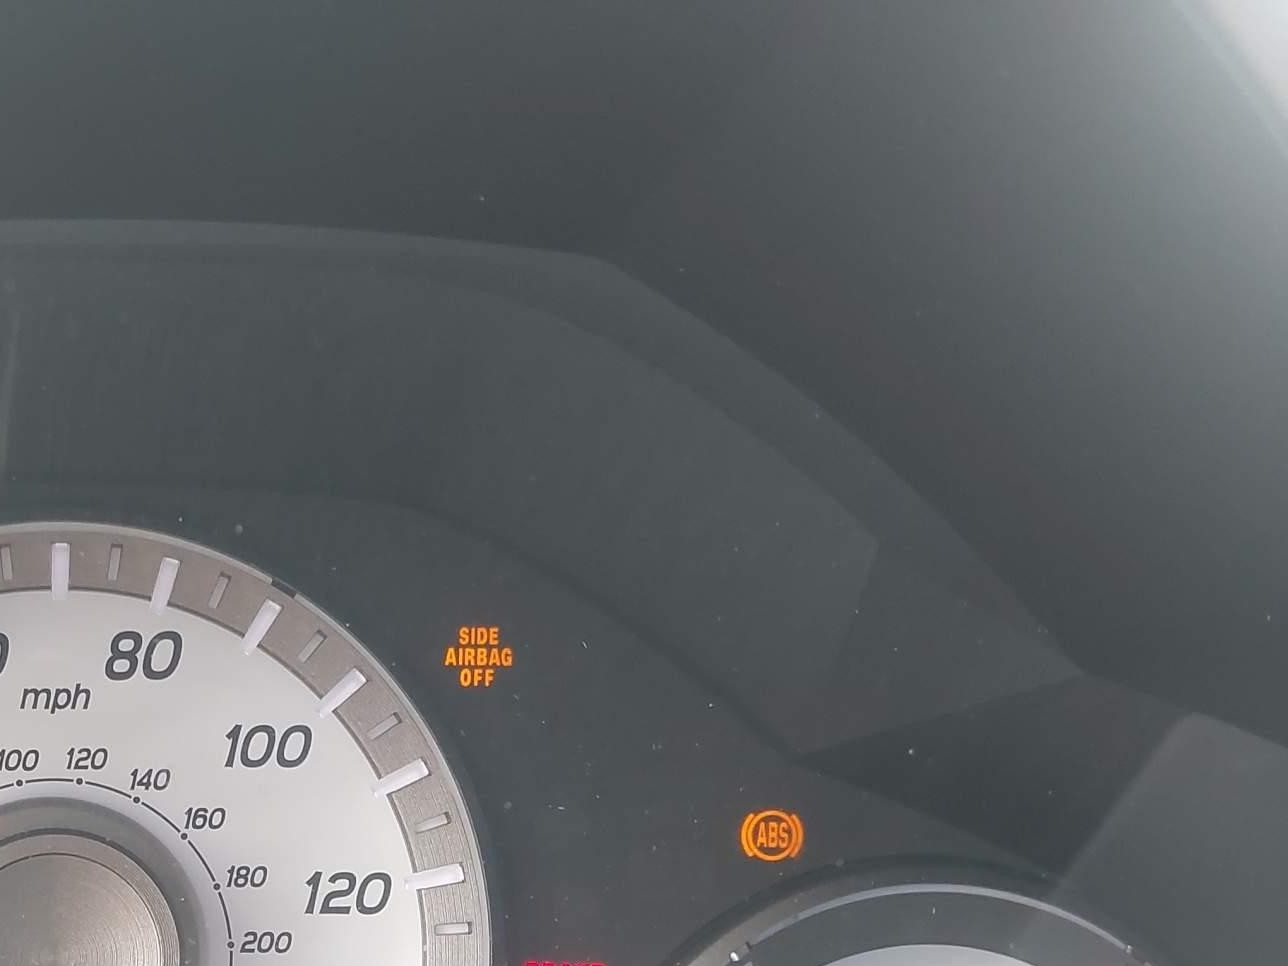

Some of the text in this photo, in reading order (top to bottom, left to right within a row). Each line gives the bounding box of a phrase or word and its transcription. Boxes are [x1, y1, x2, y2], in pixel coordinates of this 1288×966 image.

[458, 626, 499, 645] SIDE
[105, 631, 182, 680] 80
[444, 647, 513, 667] AIRBAG
[459, 668, 495, 688] OFF
[20, 684, 90, 714] mph
[225, 724, 312, 768] 100
[67, 748, 107, 769] 120
[130, 769, 170, 790] 140
[185, 808, 225, 829] 160
[756, 821, 790, 849] ABS
[226, 865, 267, 887] 180
[305, 871, 391, 914] 120
[240, 932, 292, 953] 200
